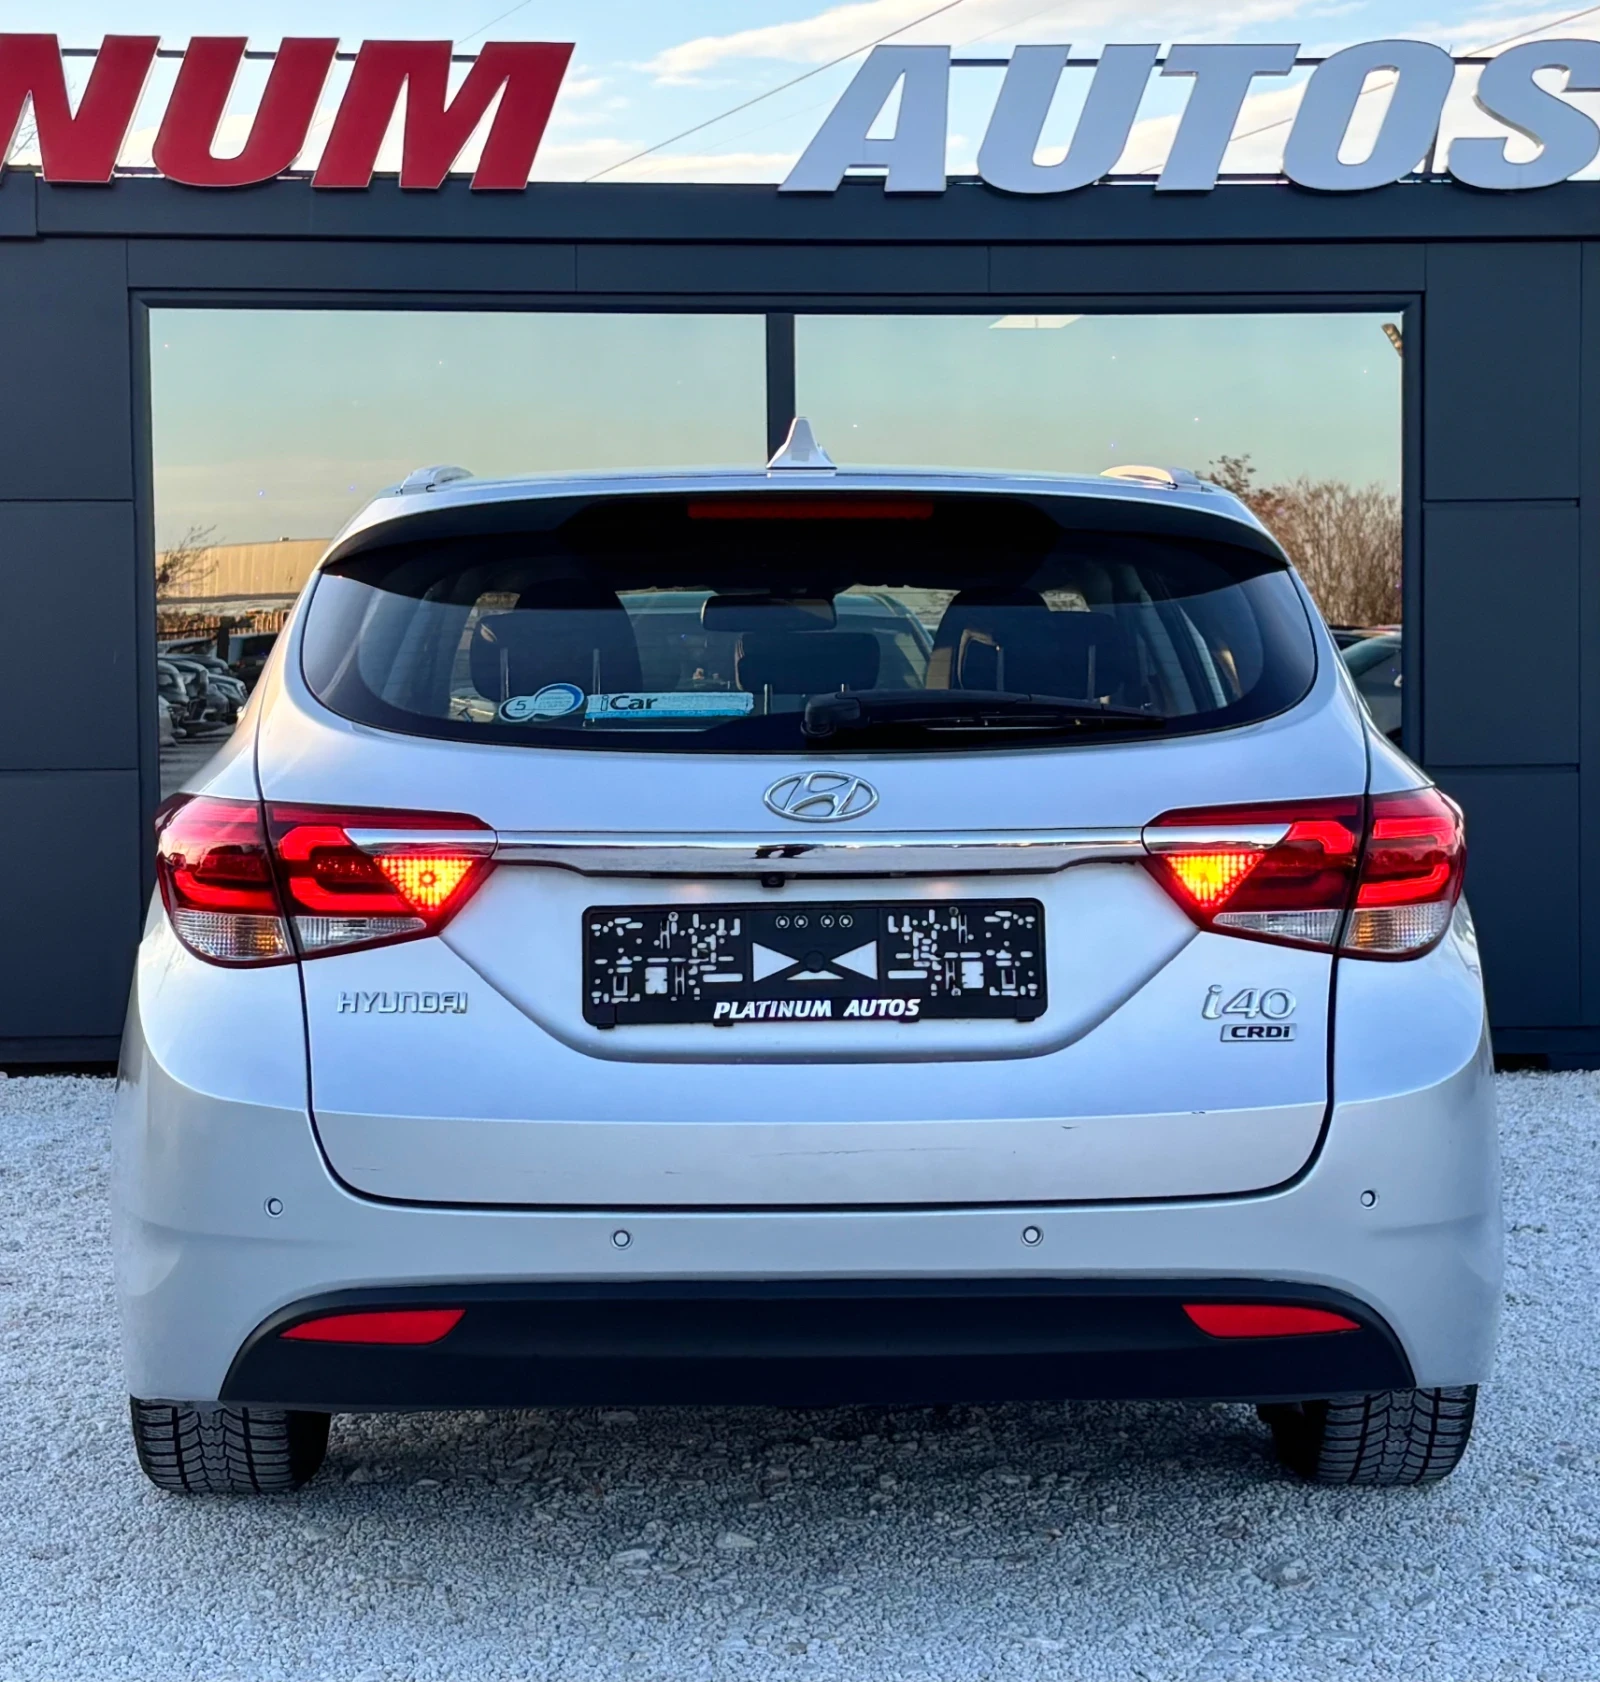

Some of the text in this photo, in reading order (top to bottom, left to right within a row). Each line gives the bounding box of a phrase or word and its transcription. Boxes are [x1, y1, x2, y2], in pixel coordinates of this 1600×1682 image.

[0, 33, 1600, 193] NUM AUTOS
[600, 695, 658, 712] iCar
[337, 991, 468, 1014] HYUNDAI
[713, 999, 920, 1019] PLATINUM AUTOS
[1201, 984, 1297, 1020] i40
[1231, 1026, 1290, 1038] CRDi
